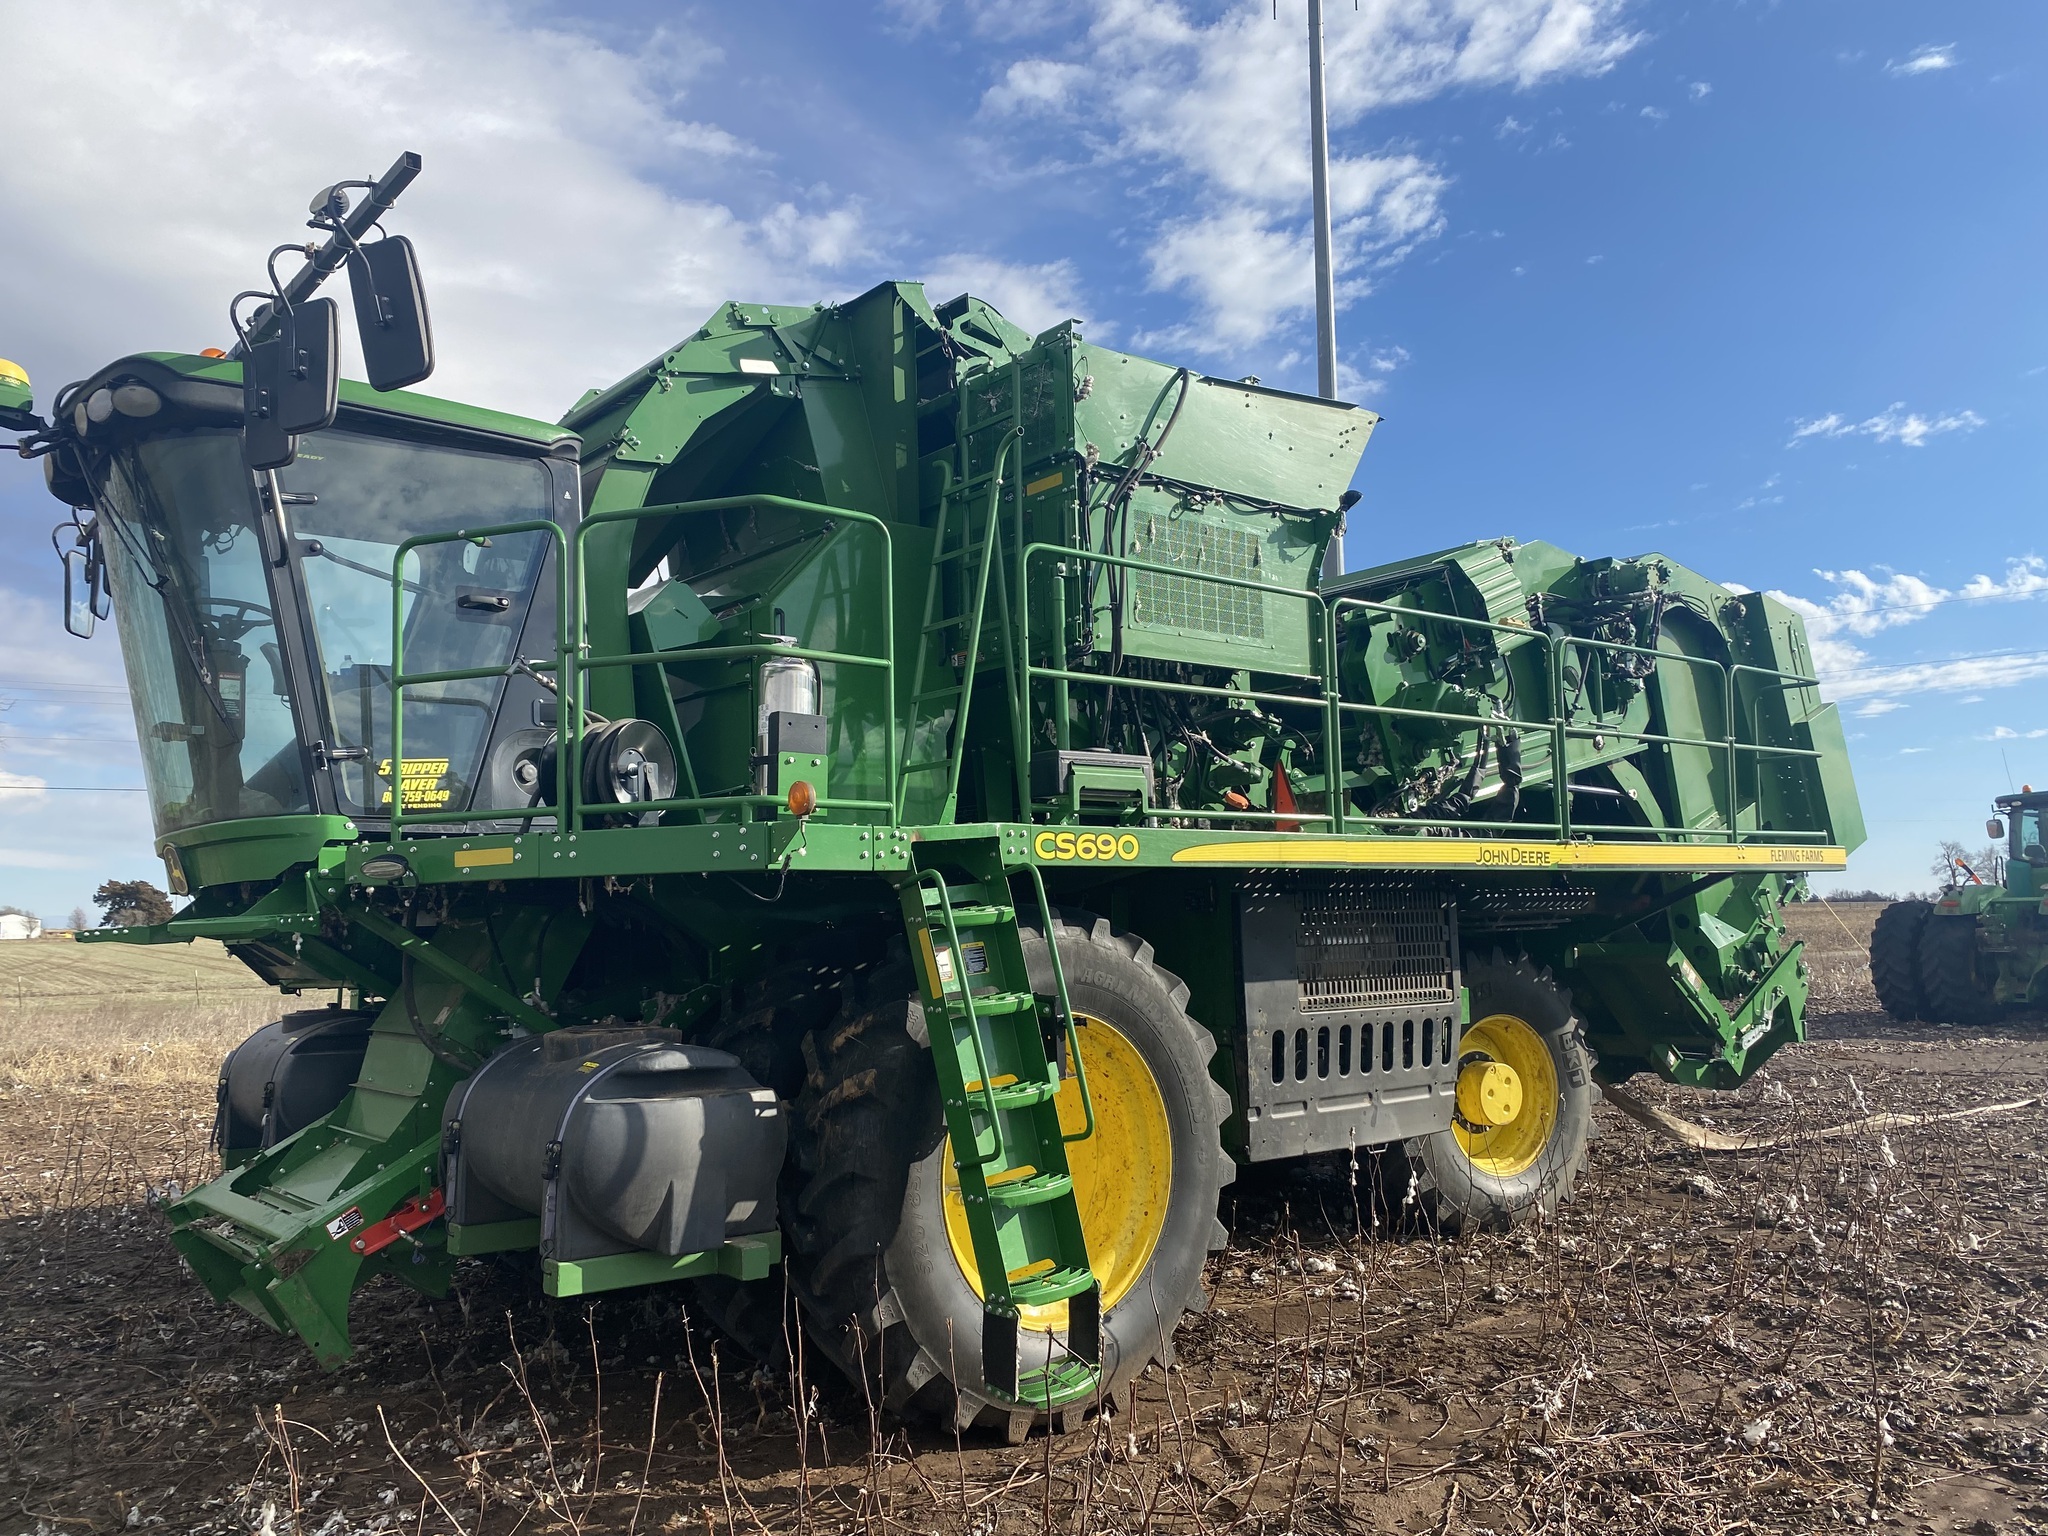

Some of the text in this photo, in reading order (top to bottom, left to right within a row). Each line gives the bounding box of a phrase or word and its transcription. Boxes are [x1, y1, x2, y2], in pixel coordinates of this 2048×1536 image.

[296, 453, 325, 461] EADY
[378, 758, 449, 775] SRIPPER
[388, 778, 438, 791] AVER
[1034, 830, 1140, 861] CS690
[1476, 846, 1551, 864] JOHN DEERE
[1770, 849, 1824, 862] FLEMING FARMS
[1561, 1031, 1585, 1085] BKT
